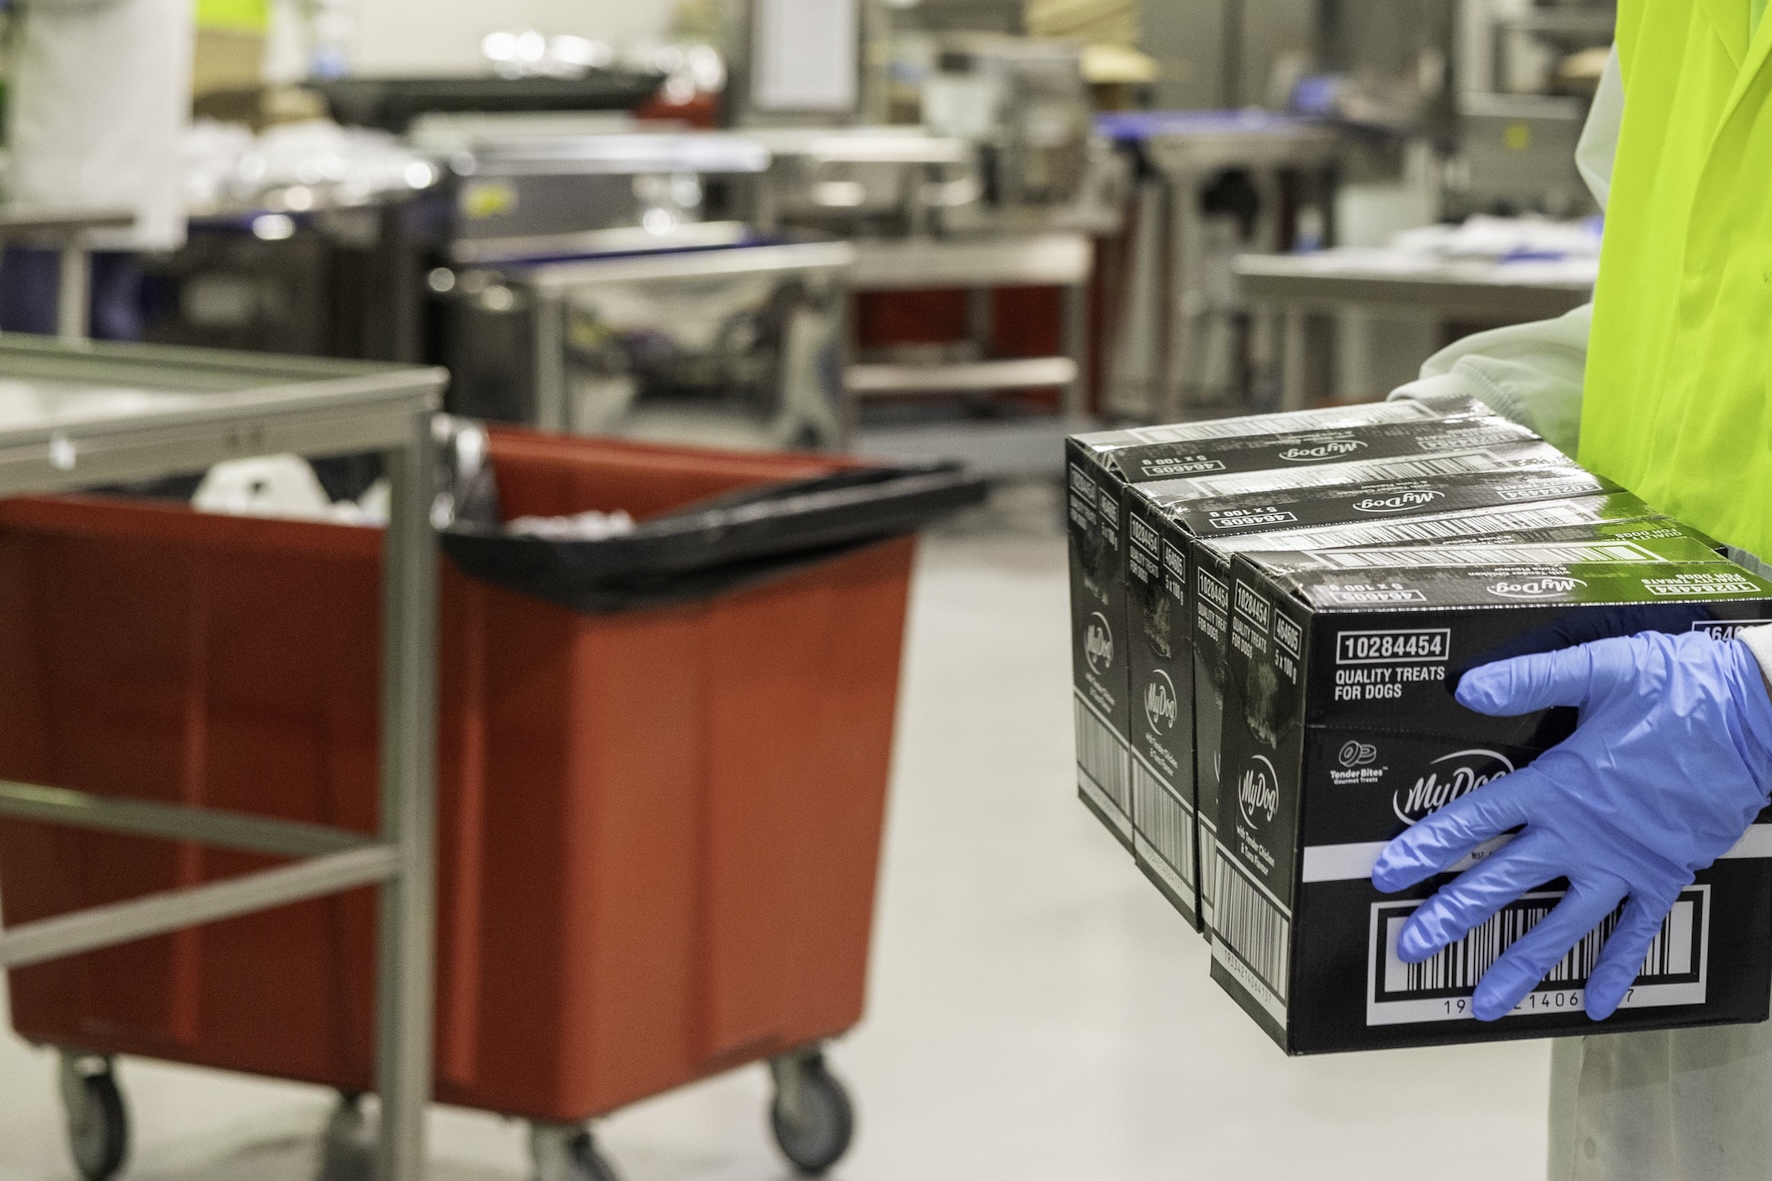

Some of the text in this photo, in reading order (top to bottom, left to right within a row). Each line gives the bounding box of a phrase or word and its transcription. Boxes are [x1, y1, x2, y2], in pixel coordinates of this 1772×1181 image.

[1155, 457, 1182, 465] 100
[1360, 490, 1435, 510] MyDog
[1220, 509, 1248, 518] 100
[1221, 513, 1285, 527] 464605
[1494, 579, 1576, 594] MyDog
[1654, 583, 1750, 593] 10284454
[1238, 586, 1268, 626] 10284454
[1344, 634, 1442, 658] 10284454
[1336, 666, 1445, 685] QUALITY TREATS
[1335, 683, 1402, 701] FOR DOGS
[1330, 769, 1360, 779] Tender
[1241, 769, 1277, 822] MyDog
